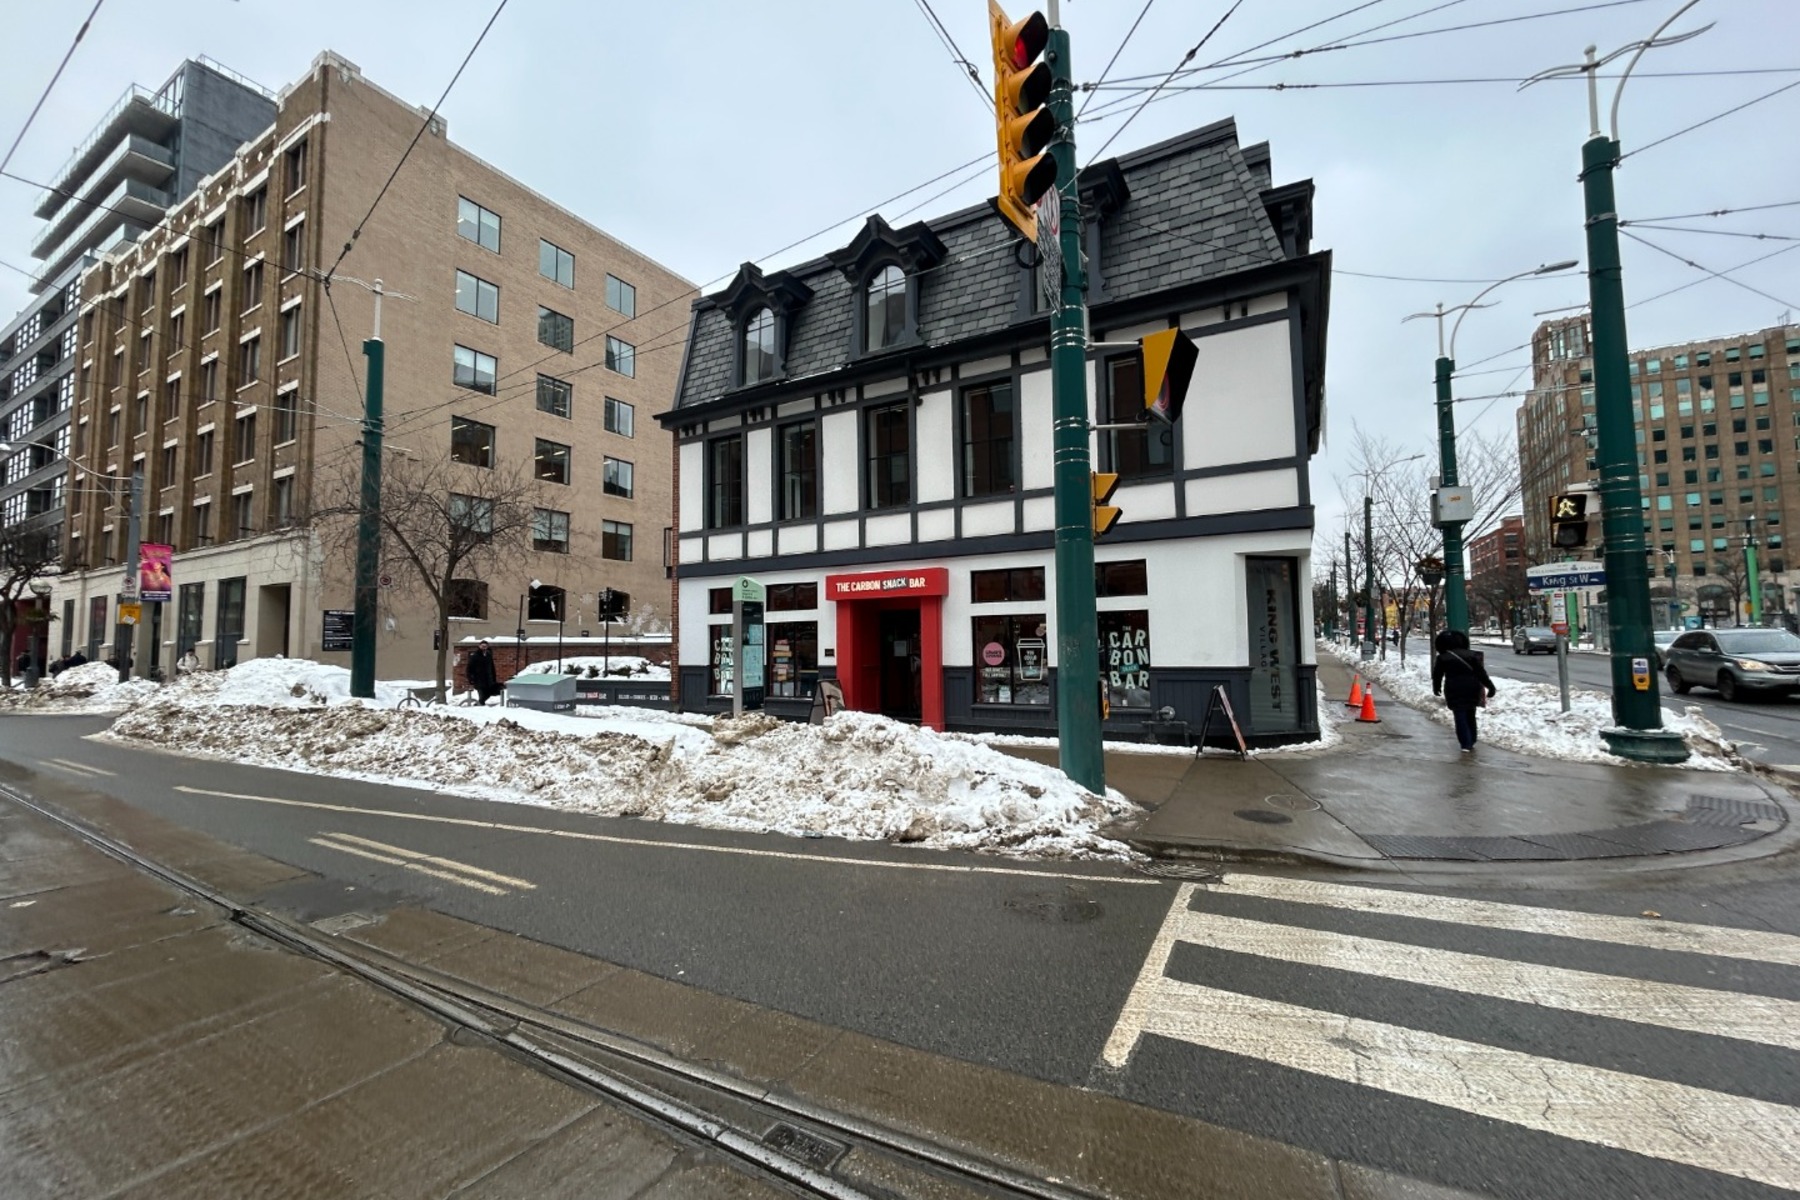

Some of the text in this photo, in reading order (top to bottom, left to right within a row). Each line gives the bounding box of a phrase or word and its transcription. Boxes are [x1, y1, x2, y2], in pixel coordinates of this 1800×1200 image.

[836, 577, 926, 593] THE CARBON SNACK BAR
[1542, 573, 1589, 587] King St W
[1109, 629, 1146, 649] CAR
[1109, 648, 1150, 666] BON
[1267, 589, 1282, 714] KING WEST
[1109, 670, 1150, 690] BAR
